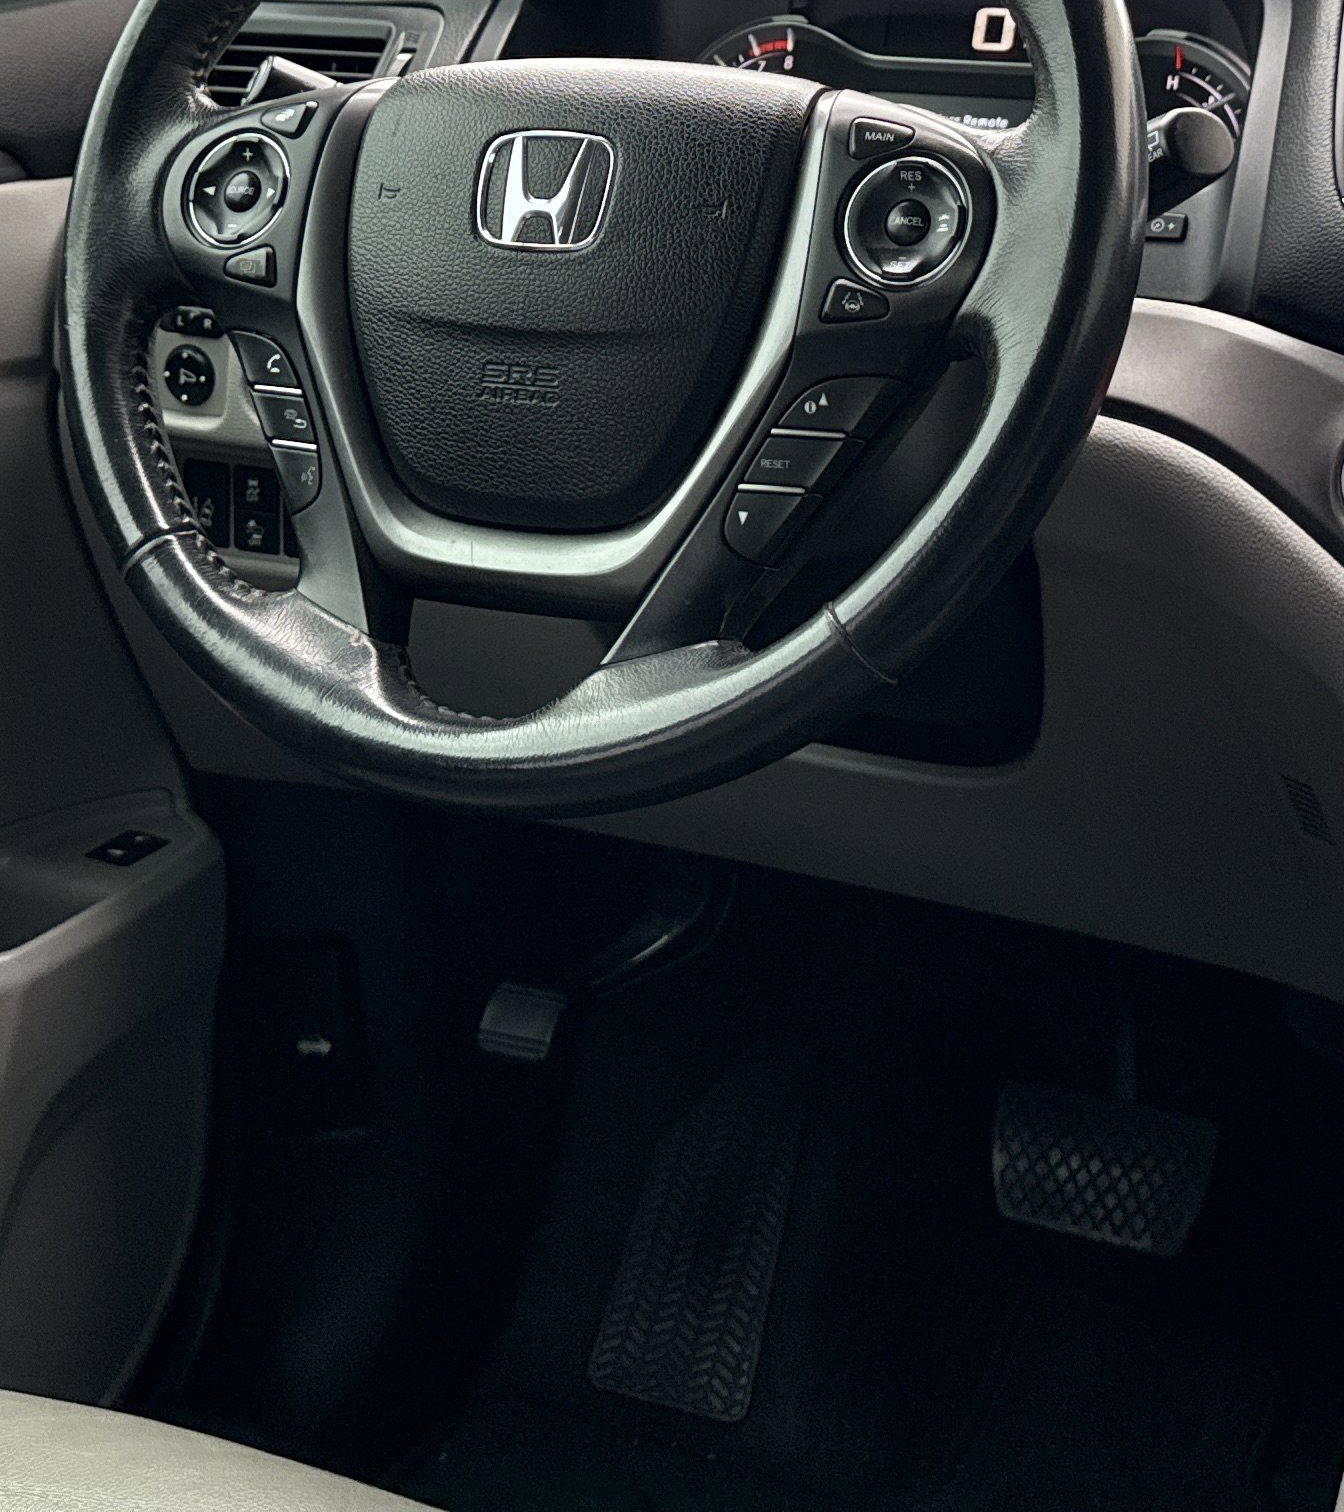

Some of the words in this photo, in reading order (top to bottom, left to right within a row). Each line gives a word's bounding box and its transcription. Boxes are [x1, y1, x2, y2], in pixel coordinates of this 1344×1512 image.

[783, 54, 795, 70] 8
[864, 131, 895, 143] MAIN
[1147, 148, 1164, 163] EAR
[900, 170, 922, 182] RES
[891, 214, 924, 227] ANCEL
[481, 362, 560, 387] SRS
[760, 459, 790, 469] RESET
